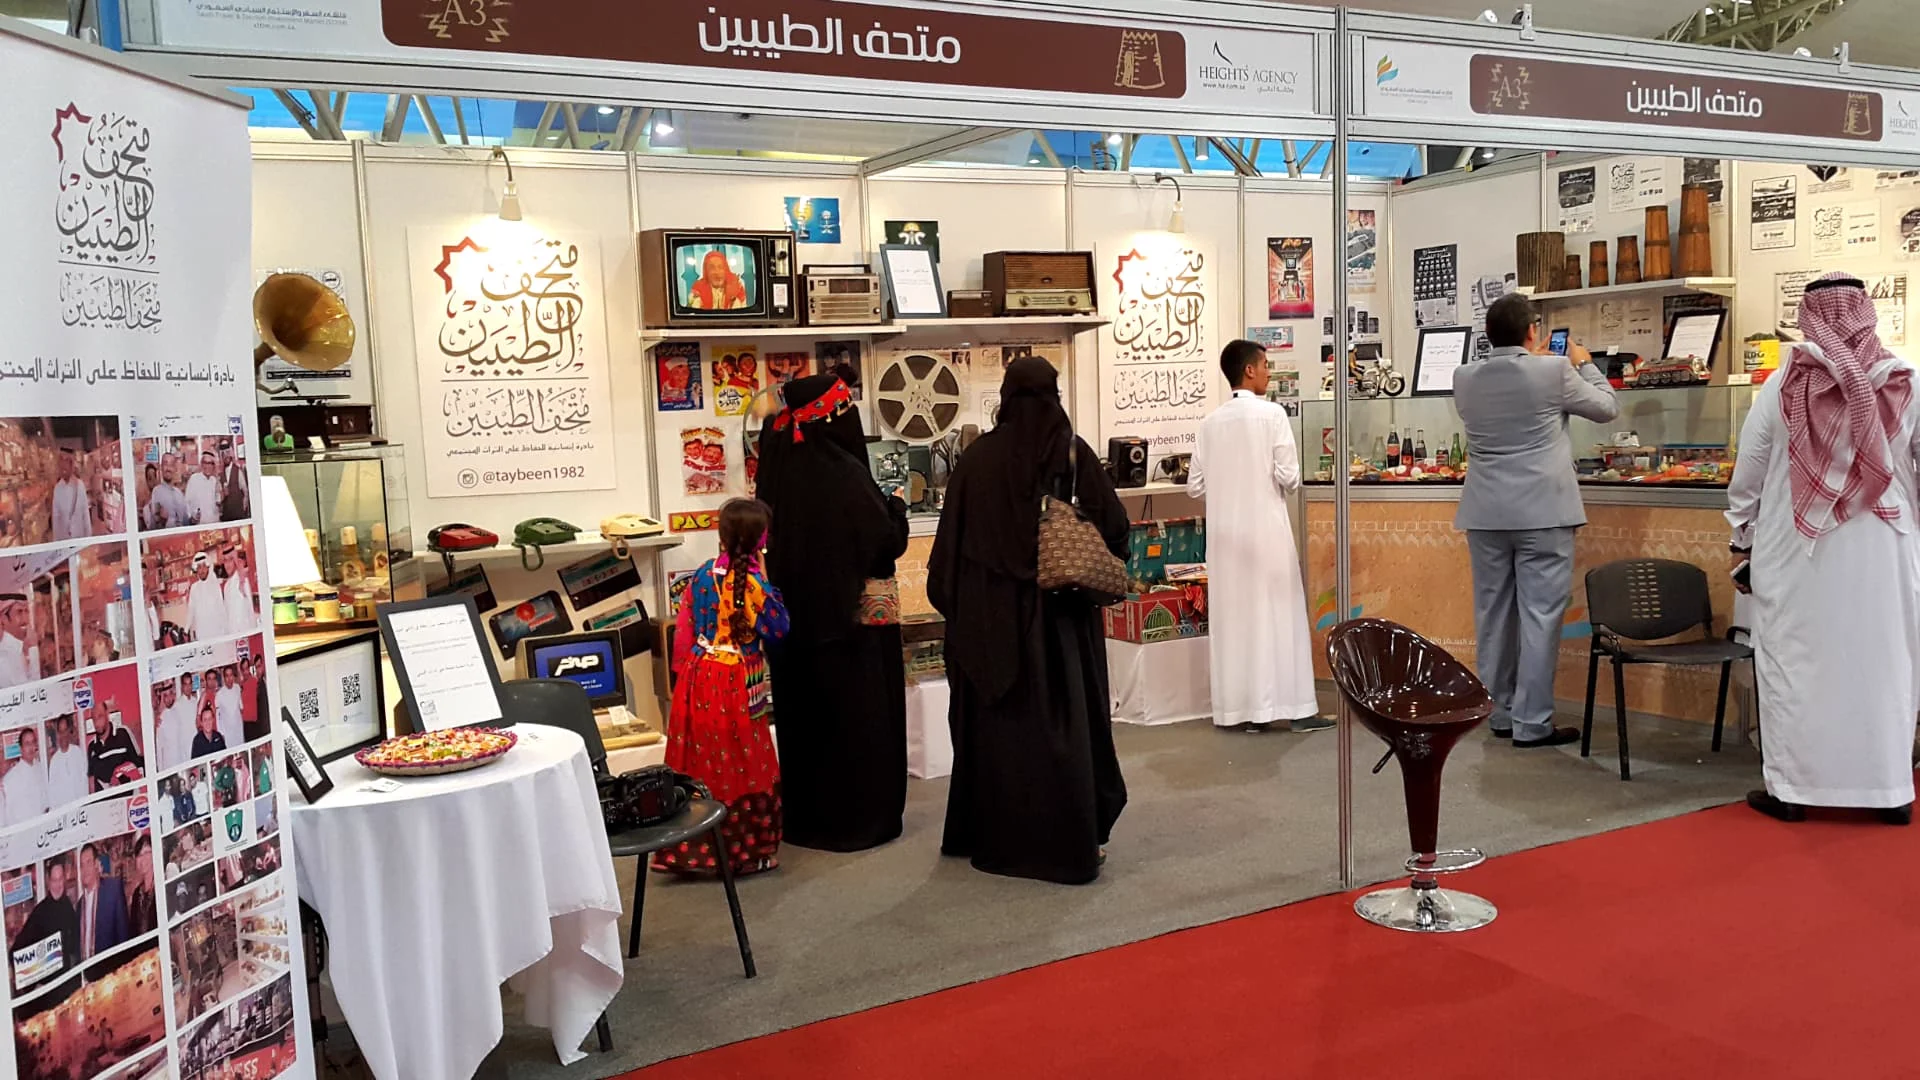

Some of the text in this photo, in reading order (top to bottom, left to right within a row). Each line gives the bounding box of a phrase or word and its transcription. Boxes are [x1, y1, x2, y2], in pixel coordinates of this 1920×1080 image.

[440, 0, 487, 26] A3
[698, 6, 962, 64] متحف الطيبين
[1252, 69, 1298, 84] AGENCY
[1499, 76, 1522, 99] A3
[1626, 80, 1763, 118] متحف الطيبين
[0, 357, 235, 387] بادرة إنسانية للحفاظ على التراث المجتم
[1144, 432, 1197, 449] taybeen198
[482, 465, 585, 484] @taybeen1982
[129, 806, 150, 818] PEPS
[14, 949, 36, 966] WAN
